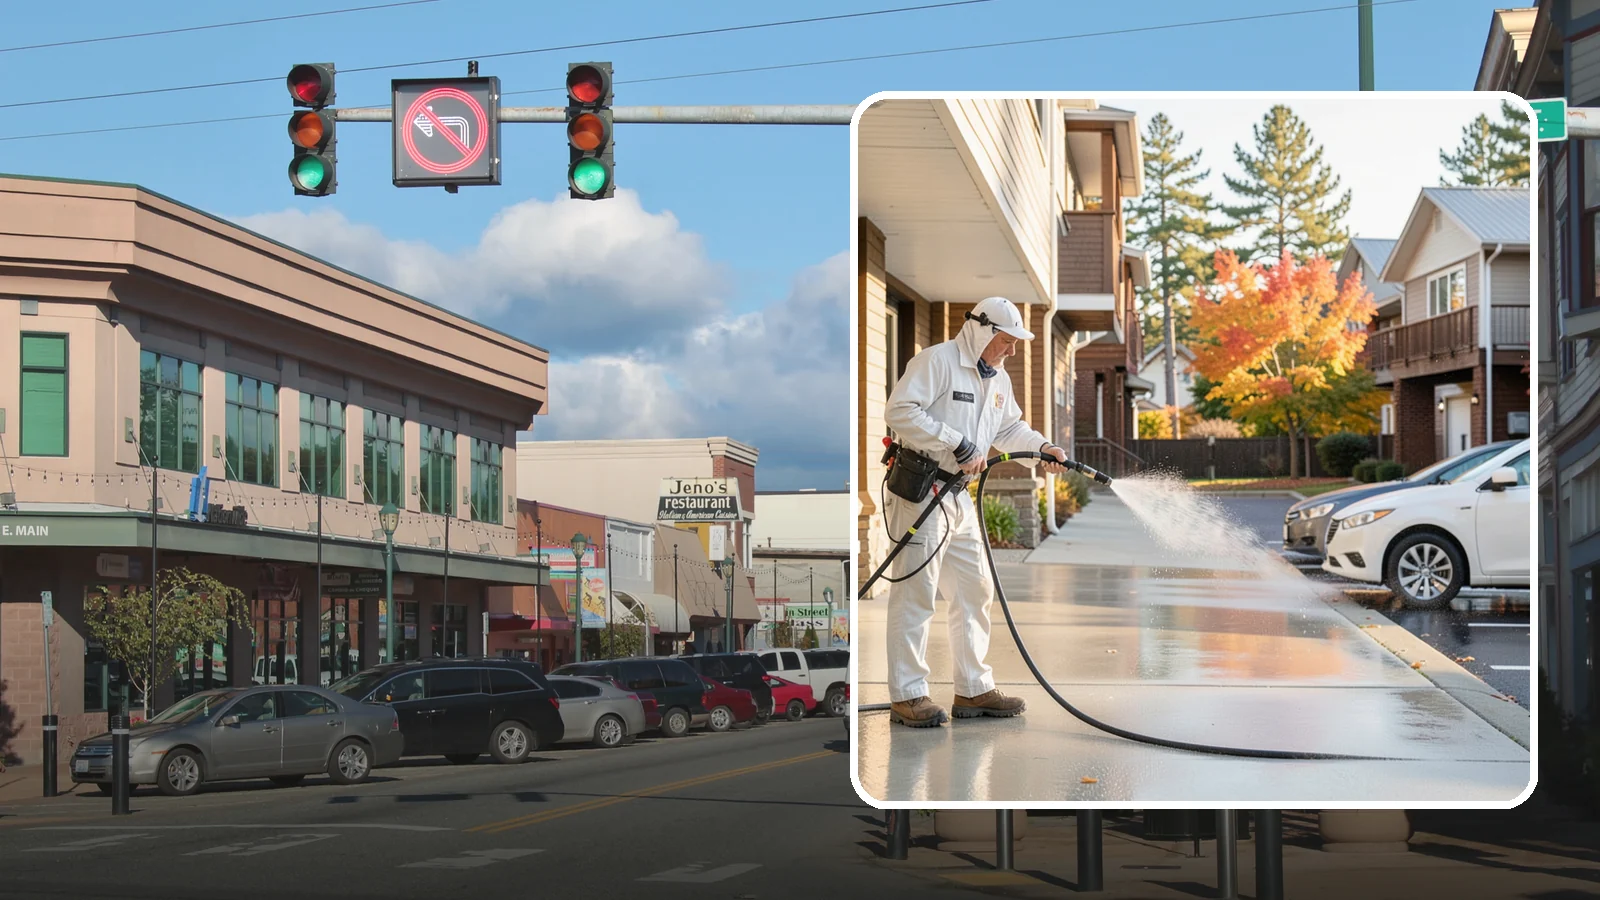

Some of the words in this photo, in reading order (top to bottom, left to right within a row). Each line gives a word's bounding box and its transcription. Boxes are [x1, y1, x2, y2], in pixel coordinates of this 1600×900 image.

[670, 480, 727, 494] Jeno's
[665, 496, 730, 508] restaurant
[685, 509, 715, 519] American
[715, 509, 738, 519] Cuisine
[2, 525, 13, 536] E.
[15, 525, 49, 536] MAIN
[798, 608, 828, 616] Street
